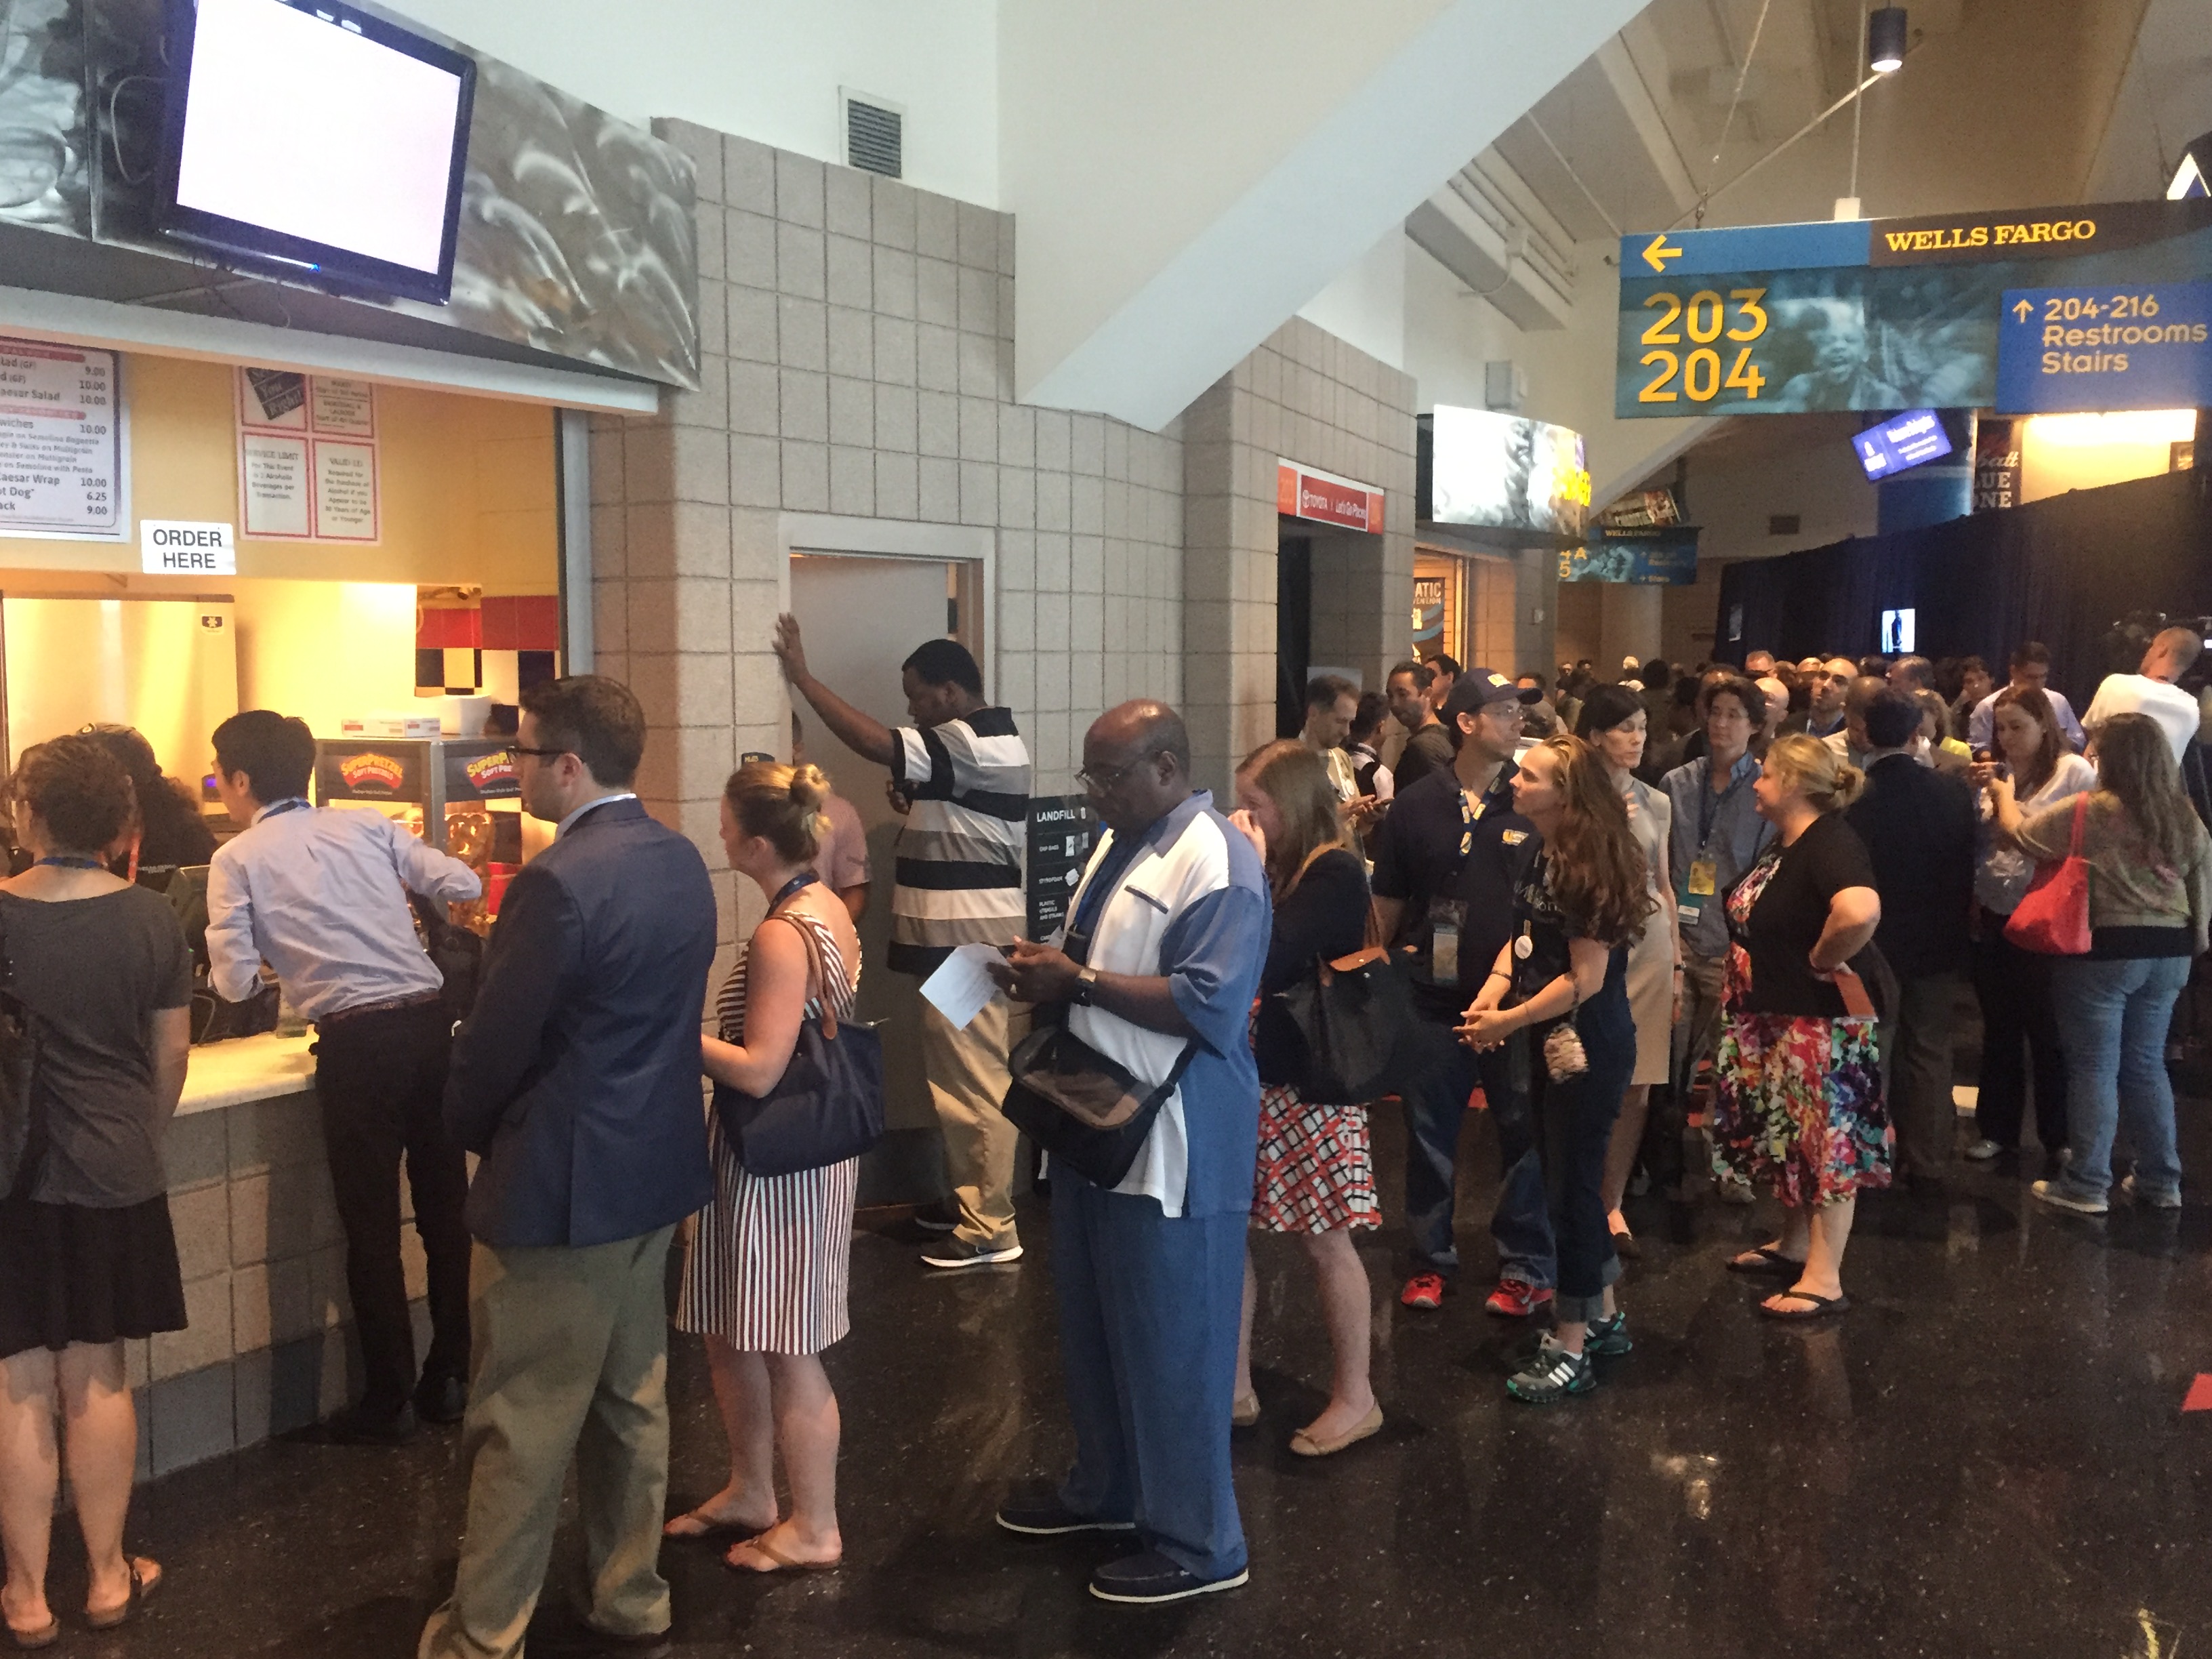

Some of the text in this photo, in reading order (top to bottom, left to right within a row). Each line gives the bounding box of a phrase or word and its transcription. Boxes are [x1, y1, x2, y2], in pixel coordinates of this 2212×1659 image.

[1885, 220, 2097, 252] WELLS FARGO
[2044, 294, 2160, 321] 204-216
[1641, 288, 1767, 345] 203
[2042, 323, 2209, 348] Restrooms
[2042, 351, 2129, 374] Stairs
[85, 367, 106, 377] 9.00
[1639, 348, 1766, 402] 204
[79, 380, 106, 391] 10.00
[32, 390, 60, 401] Salad
[79, 395, 106, 405] 10.00
[80, 424, 106, 435] 10.00
[34, 474, 60, 486] Wrap
[81, 477, 107, 487] 10.00
[87, 492, 107, 501] 6.25
[87, 506, 108, 515] 9.00
[153, 529, 222, 547] ORDER
[163, 552, 216, 569] HERE
[481, 766, 498, 779] SOFT
[1037, 809, 1076, 822] LANDFILL
